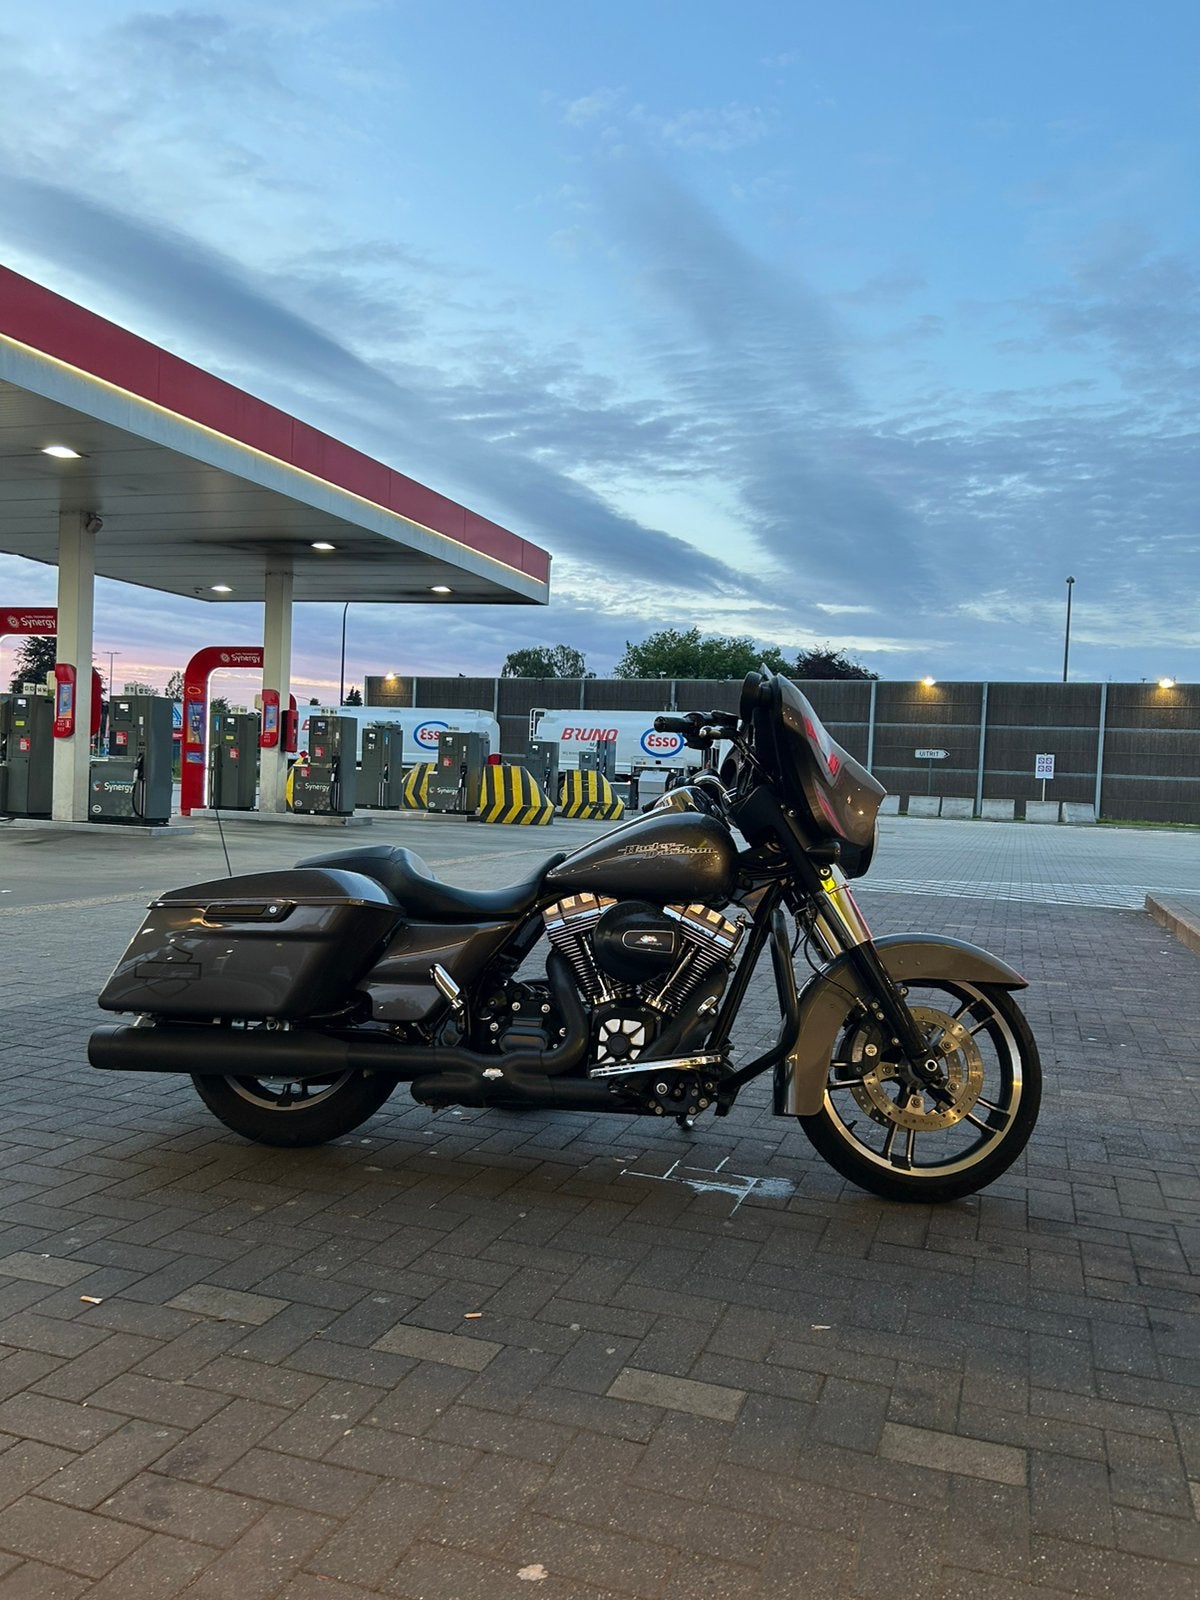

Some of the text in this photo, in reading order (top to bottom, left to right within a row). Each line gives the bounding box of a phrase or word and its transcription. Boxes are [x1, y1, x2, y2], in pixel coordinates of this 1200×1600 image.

[20, 616, 56, 629] Synergy
[230, 653, 261, 664] Synergy
[420, 728, 446, 740] Ess
[561, 727, 618, 742] BRUNO
[103, 781, 134, 794] Synergy
[304, 782, 330, 793] Synergy
[436, 787, 459, 796] Synergy
